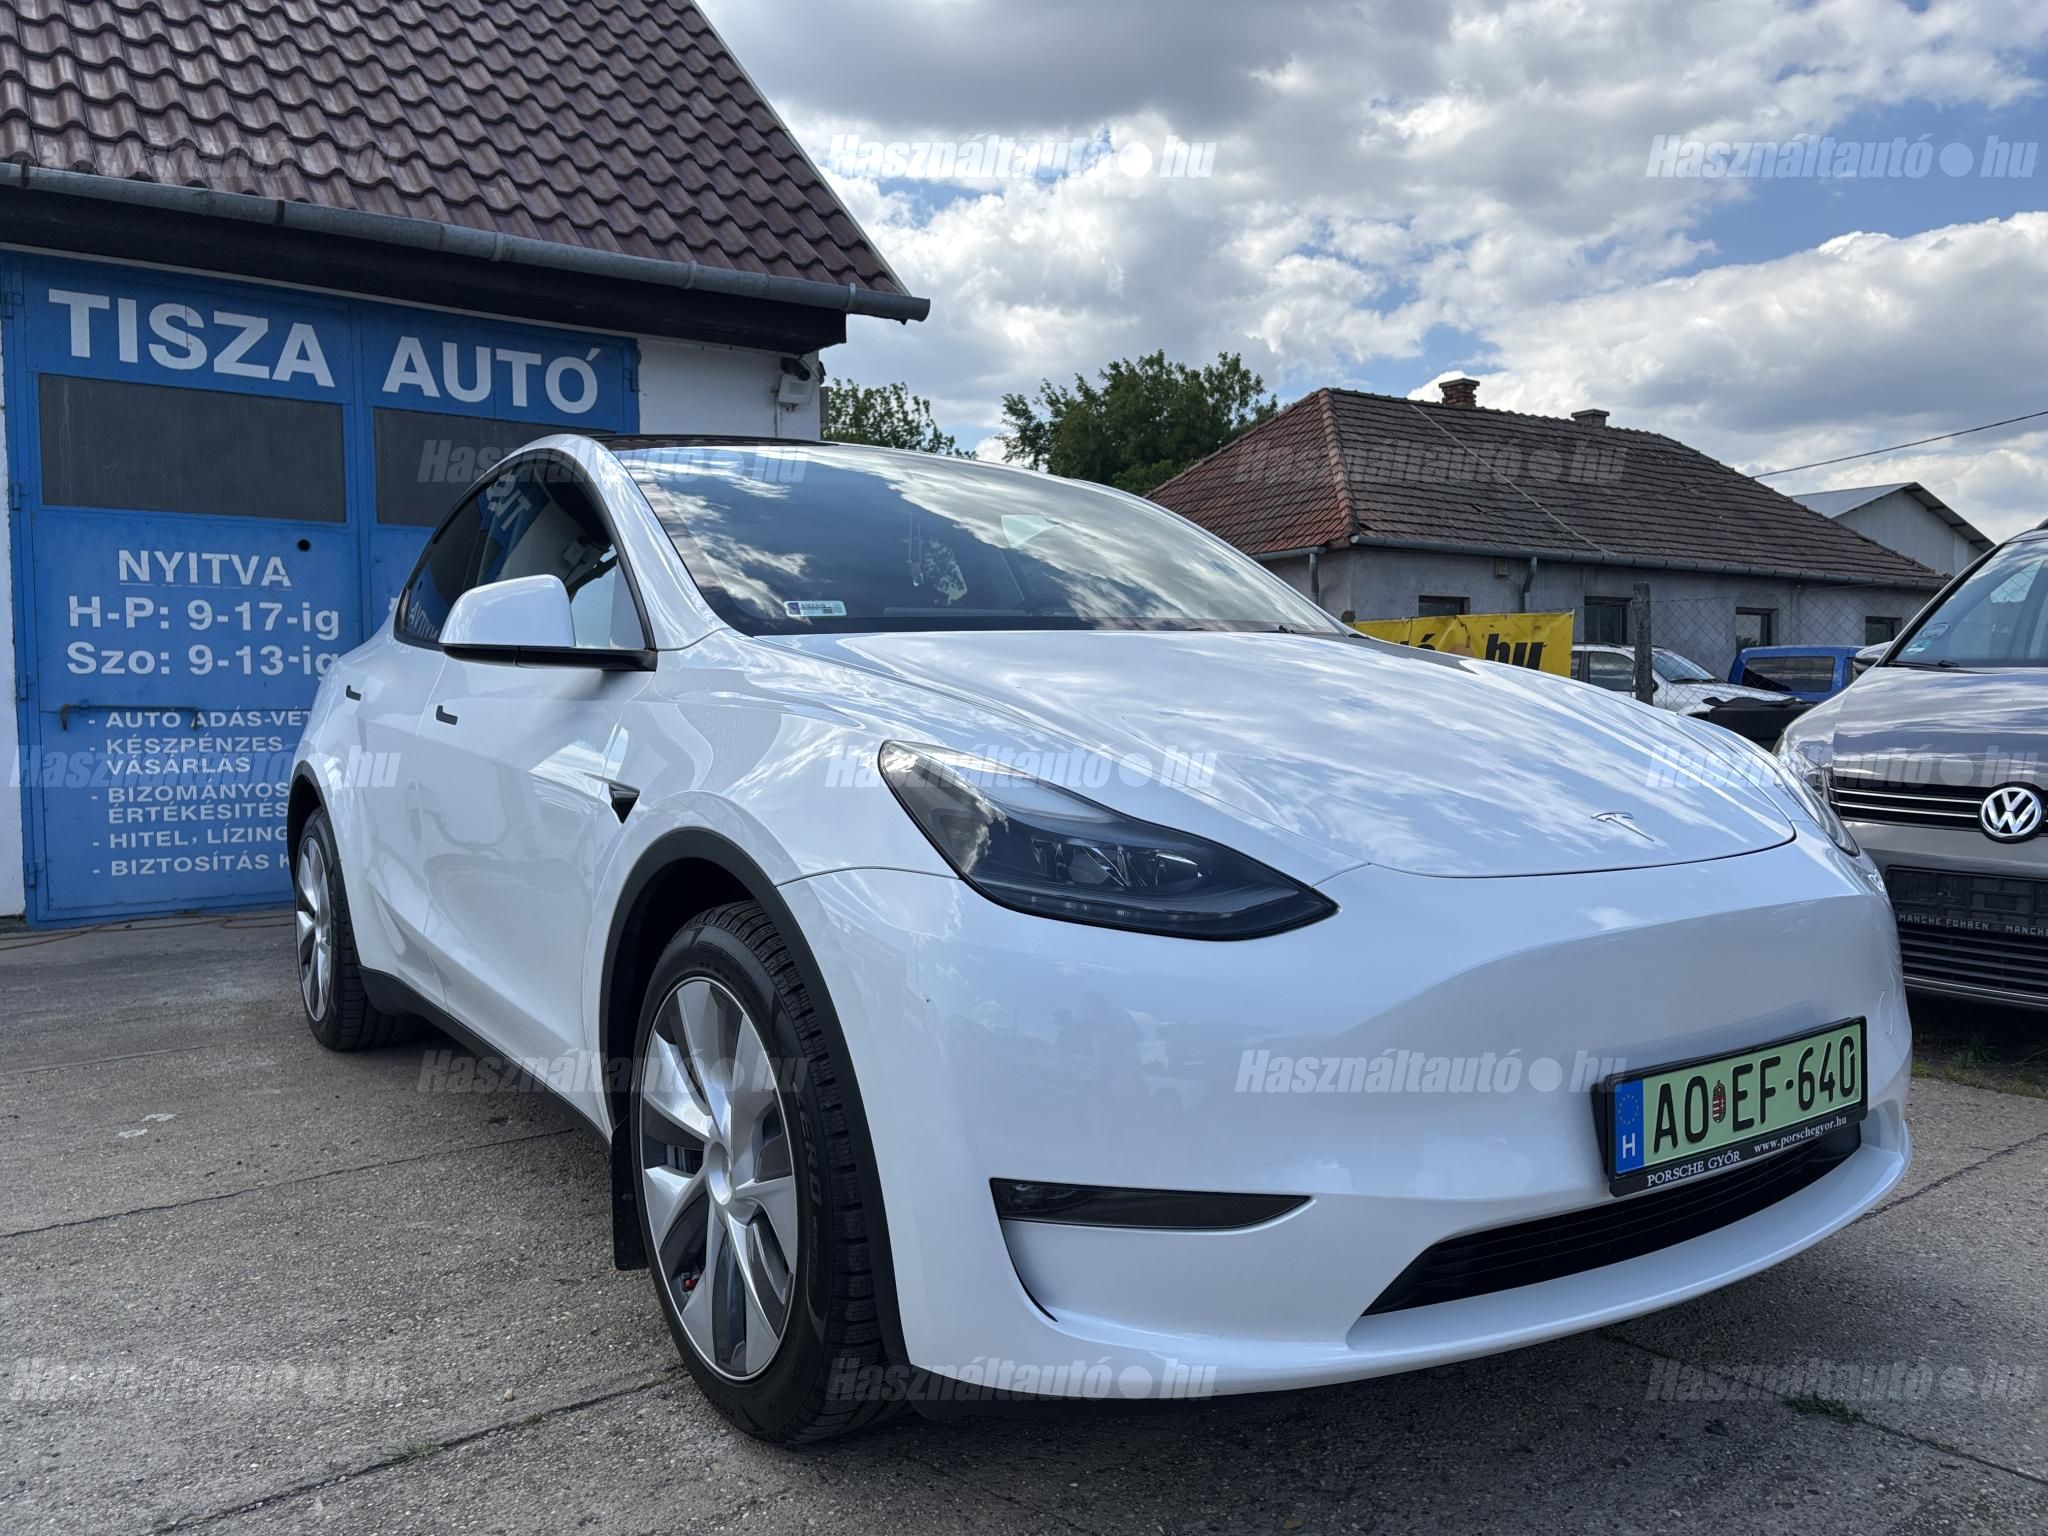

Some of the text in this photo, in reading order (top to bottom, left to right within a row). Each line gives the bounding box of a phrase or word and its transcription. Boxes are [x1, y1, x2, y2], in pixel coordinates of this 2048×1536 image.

[49, 288, 601, 415] TISZA AUTÓ
[118, 549, 292, 588] NYITVA
[68, 595, 340, 641] H-P: 9-17-ig
[67, 641, 170, 675] Szo:
[106, 708, 181, 728] AUTÓ
[107, 733, 283, 755] KÉSZPÉNZES
[107, 754, 251, 776] VÁSÁRLÁS
[109, 779, 289, 803] BIZOMÁNYOS
[110, 824, 287, 849] HITEL, LÍZING
[112, 850, 270, 877] BIZTOSÍTÁS
[1621, 1132, 1636, 1159] H
[1647, 1116, 1848, 1187] PORSCHE GYŐR www.porschegyor.hu
